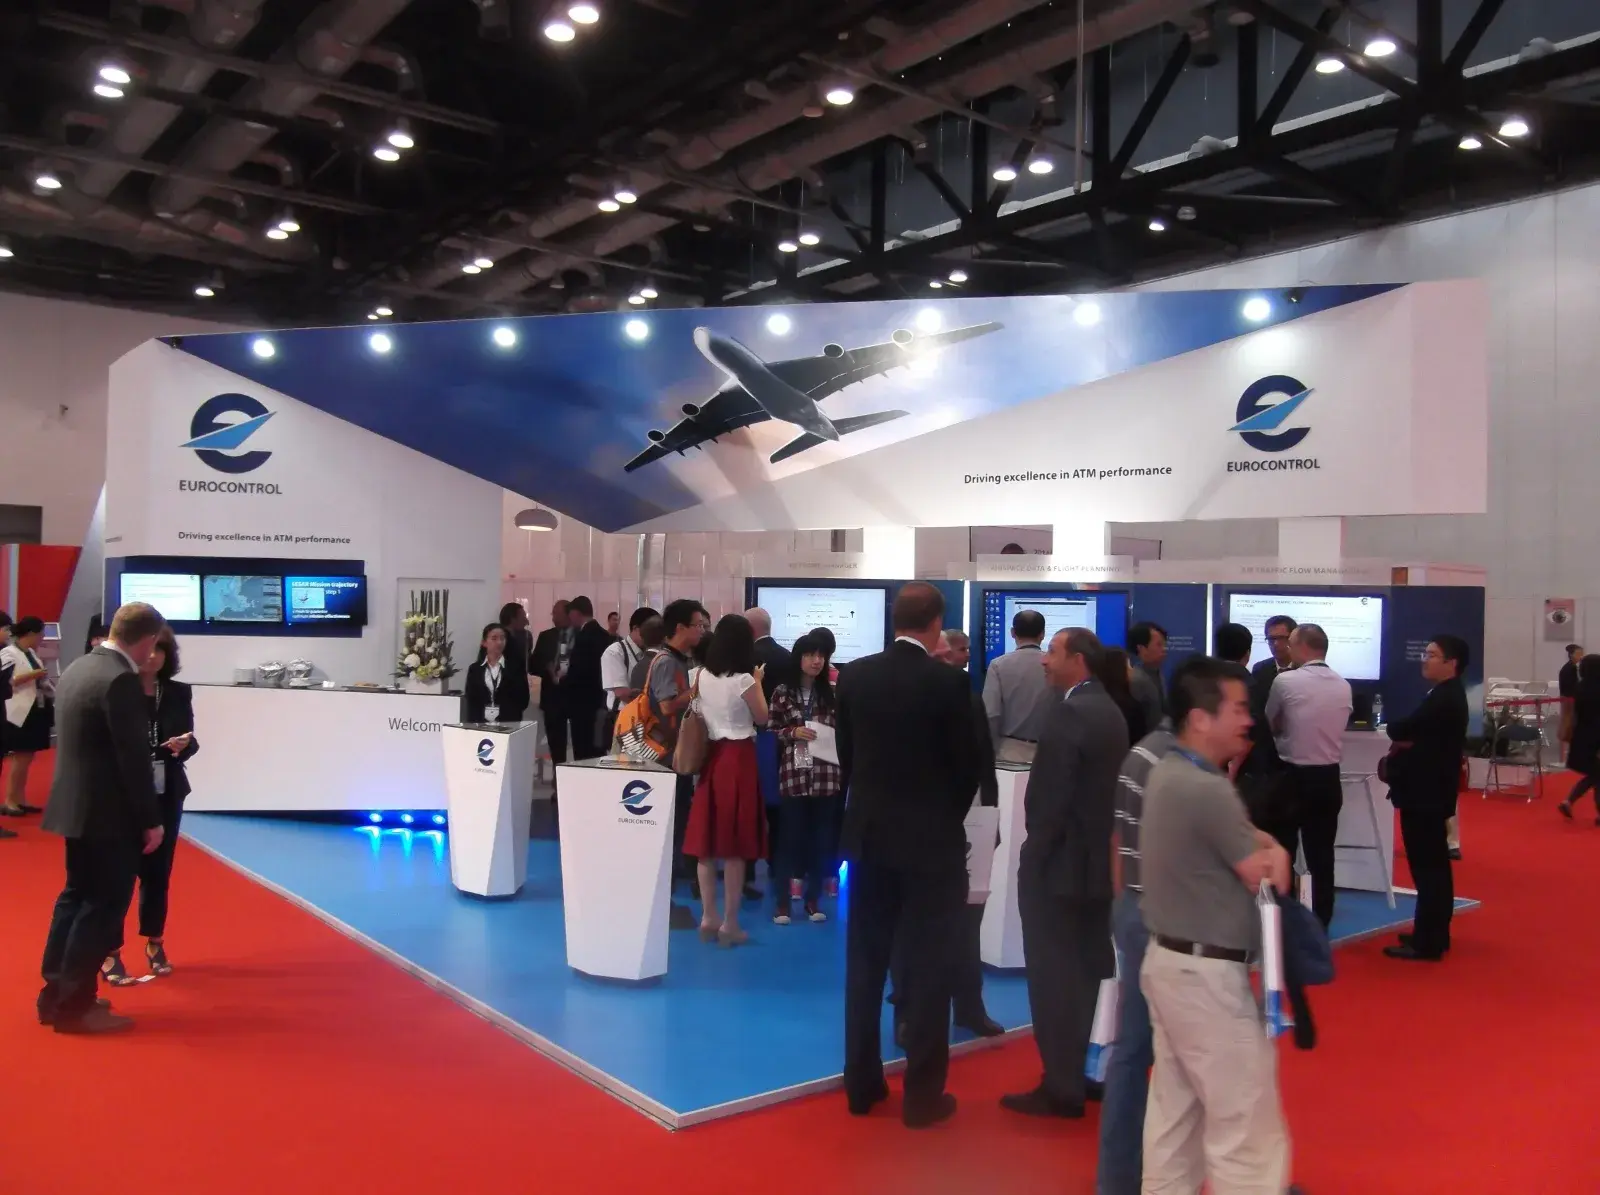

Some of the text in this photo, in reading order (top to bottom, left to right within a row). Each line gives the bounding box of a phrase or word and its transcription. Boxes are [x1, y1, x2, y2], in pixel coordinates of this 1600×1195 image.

[1227, 458, 1320, 473] EUROCONTROL
[964, 465, 1172, 485] Driving excellence in ATM performance
[179, 480, 282, 495] EUROCONTROL
[178, 531, 351, 544] Driving excellence in ATM performance
[388, 717, 442, 733] Welcom
